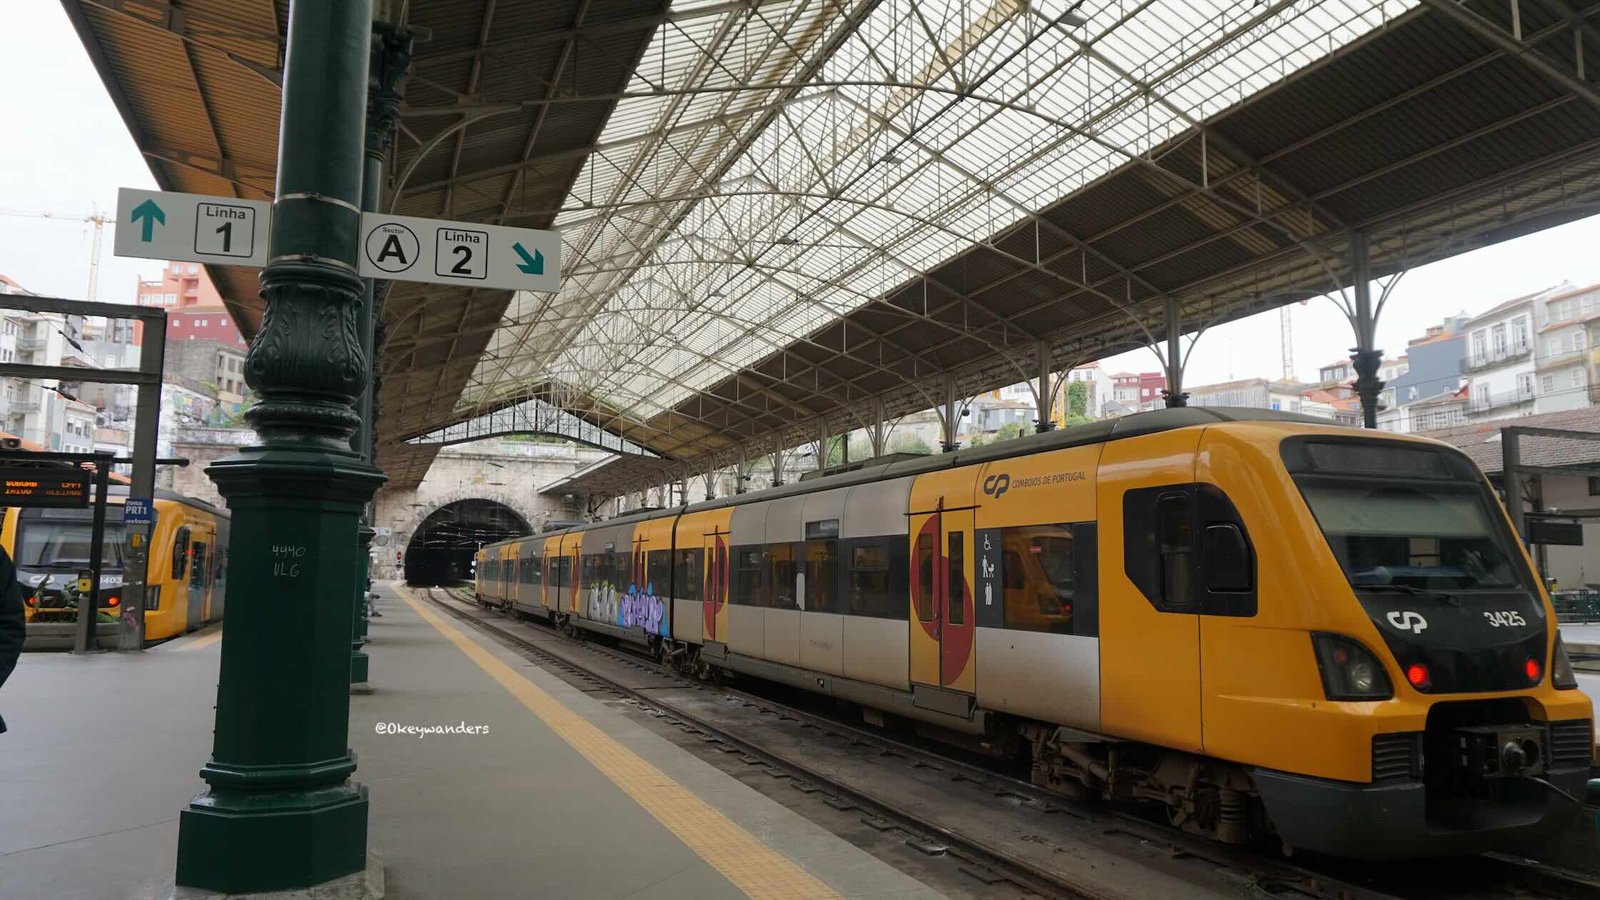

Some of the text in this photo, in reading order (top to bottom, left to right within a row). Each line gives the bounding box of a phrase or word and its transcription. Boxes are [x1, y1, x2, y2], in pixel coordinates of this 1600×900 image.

[206, 205, 246, 220] Linha
[215, 221, 232, 252] 1
[382, 226, 404, 235] Sector
[444, 231, 480, 244] Linha
[376, 234, 408, 264] A
[450, 245, 473, 275] 2
[1012, 476, 1041, 488] COMBOIOS
[1042, 475, 1051, 485] DE
[1052, 471, 1086, 484] PORTUGAL
[125, 506, 147, 515] PRT1
[1484, 611, 1527, 627] 3425
